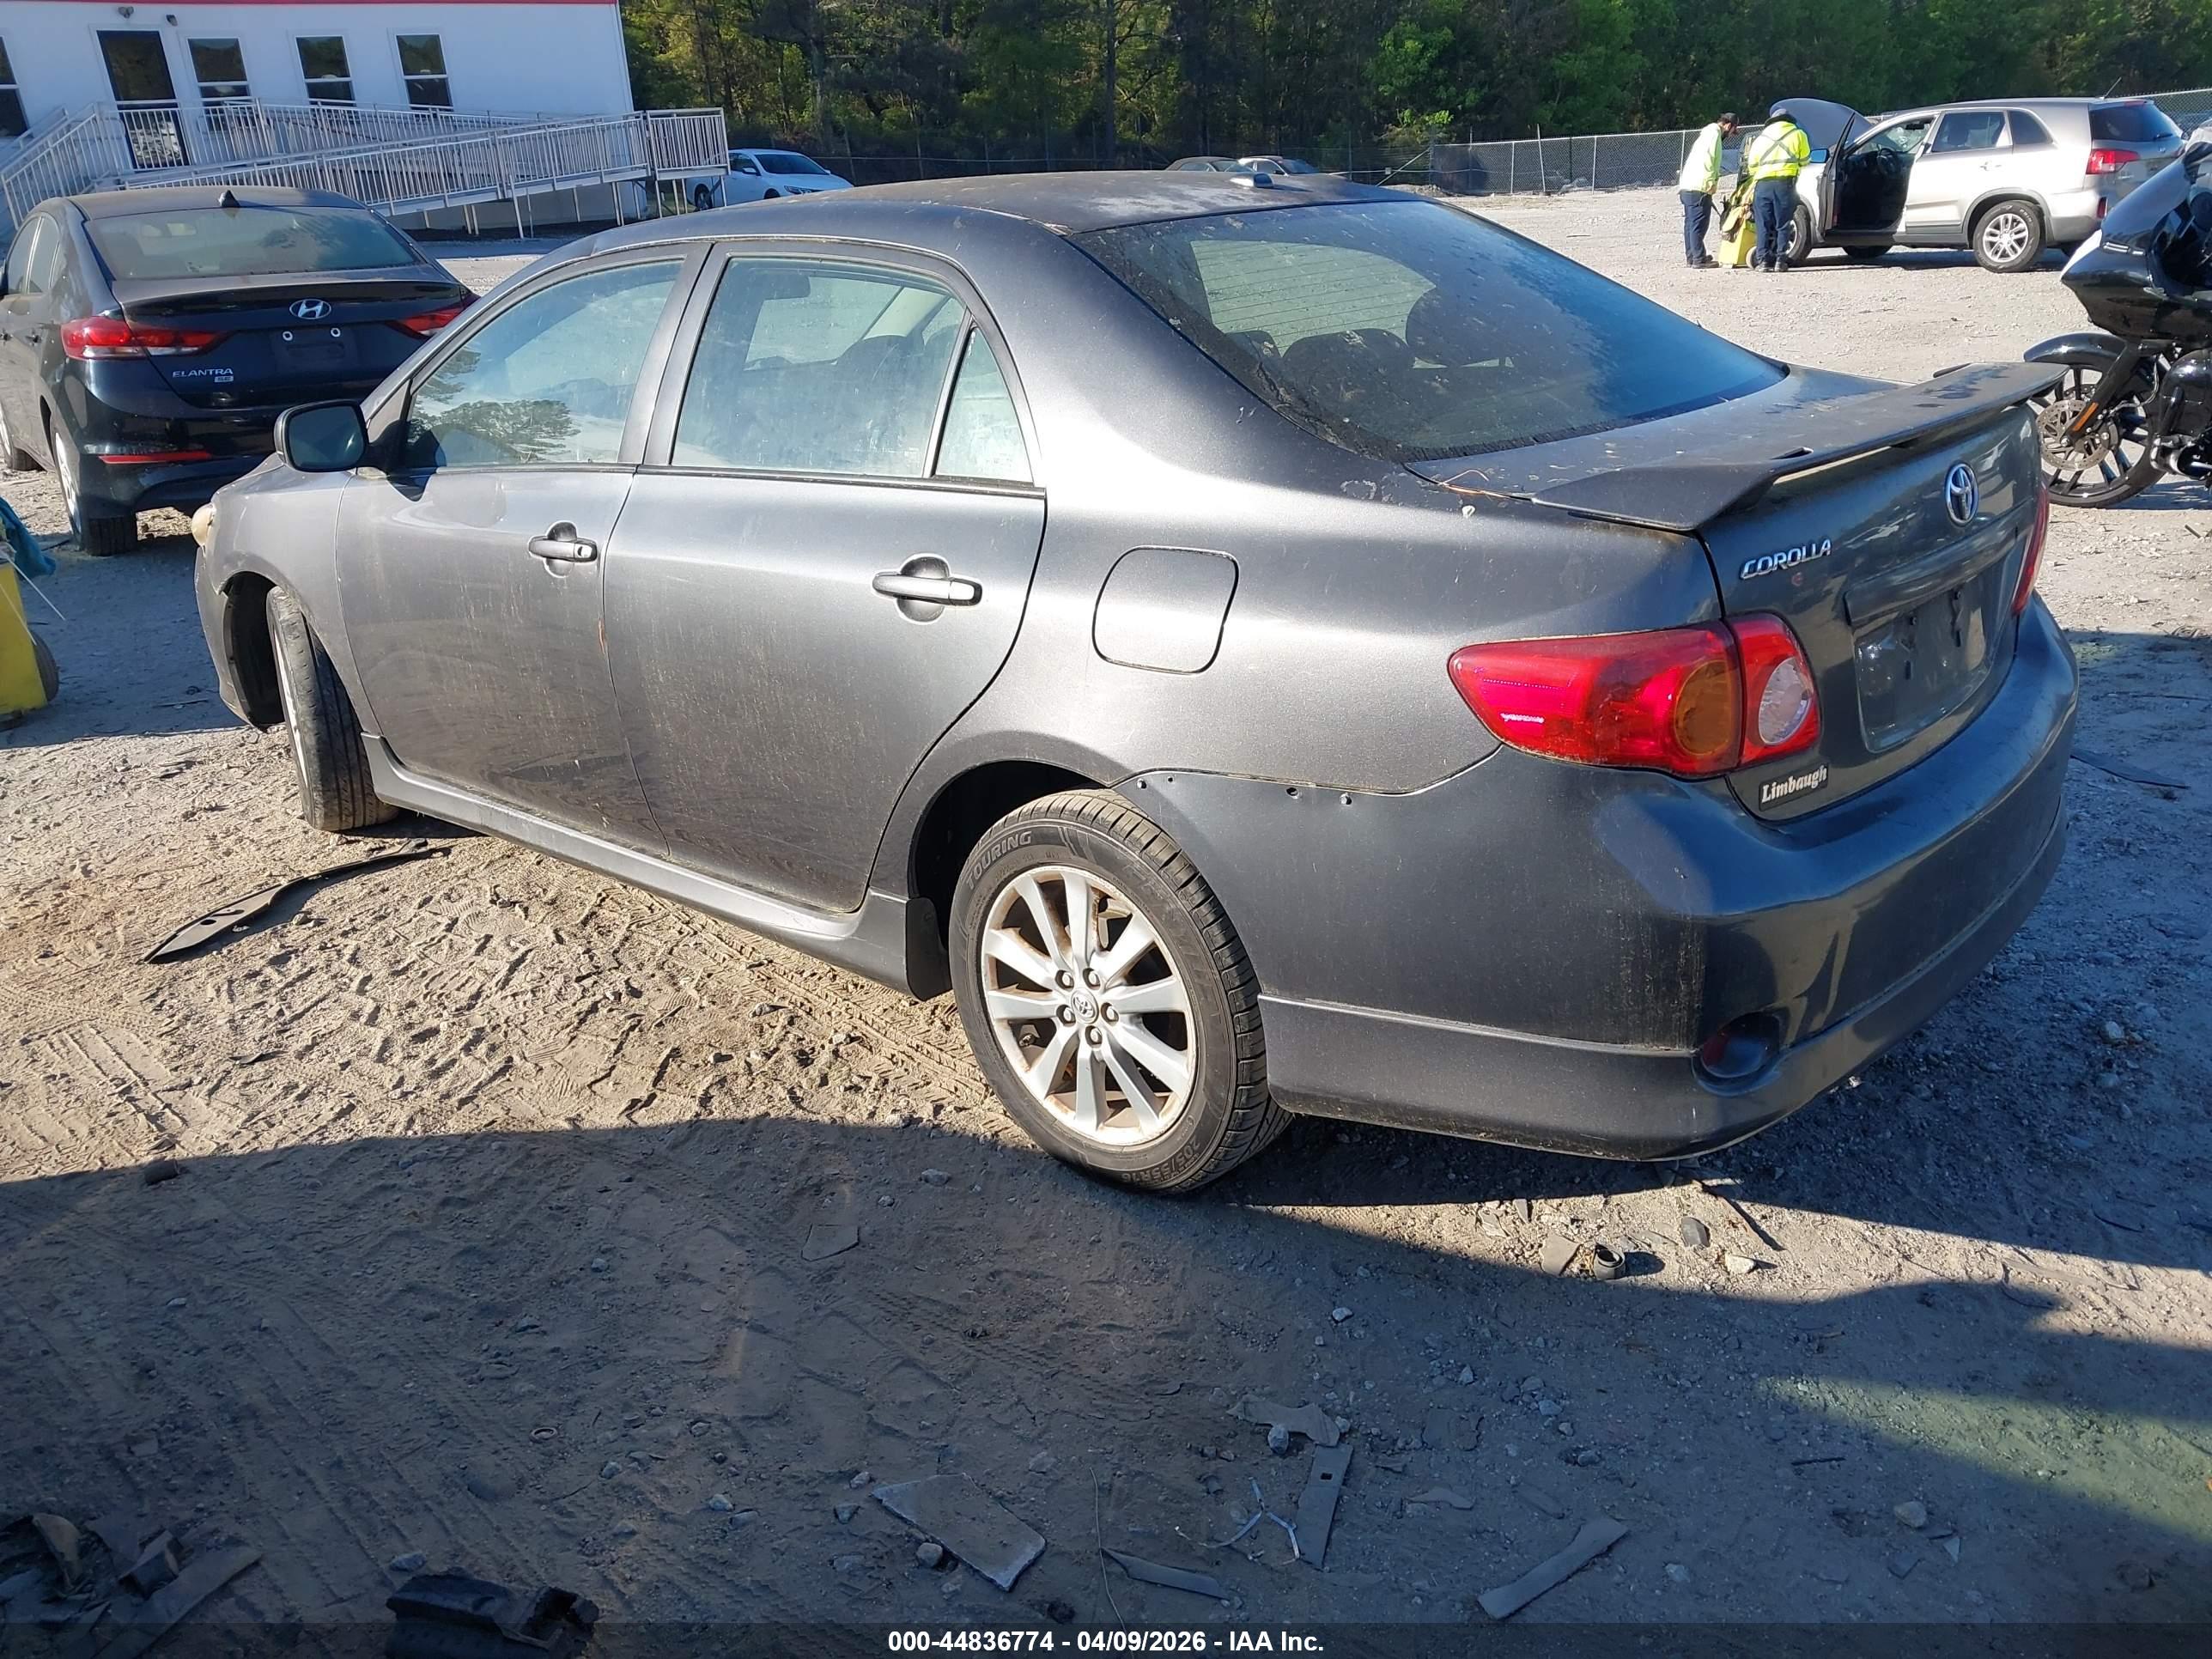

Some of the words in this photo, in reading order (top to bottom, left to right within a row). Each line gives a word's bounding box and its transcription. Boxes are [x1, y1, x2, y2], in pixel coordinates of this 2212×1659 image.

[173, 368, 234, 378] ELANTRA
[1741, 538, 1832, 579] COROLLA
[1761, 764, 1827, 804] Limbaugh
[966, 830, 1032, 890] TOURING
[1121, 1138, 1201, 1182] 205/55R16
